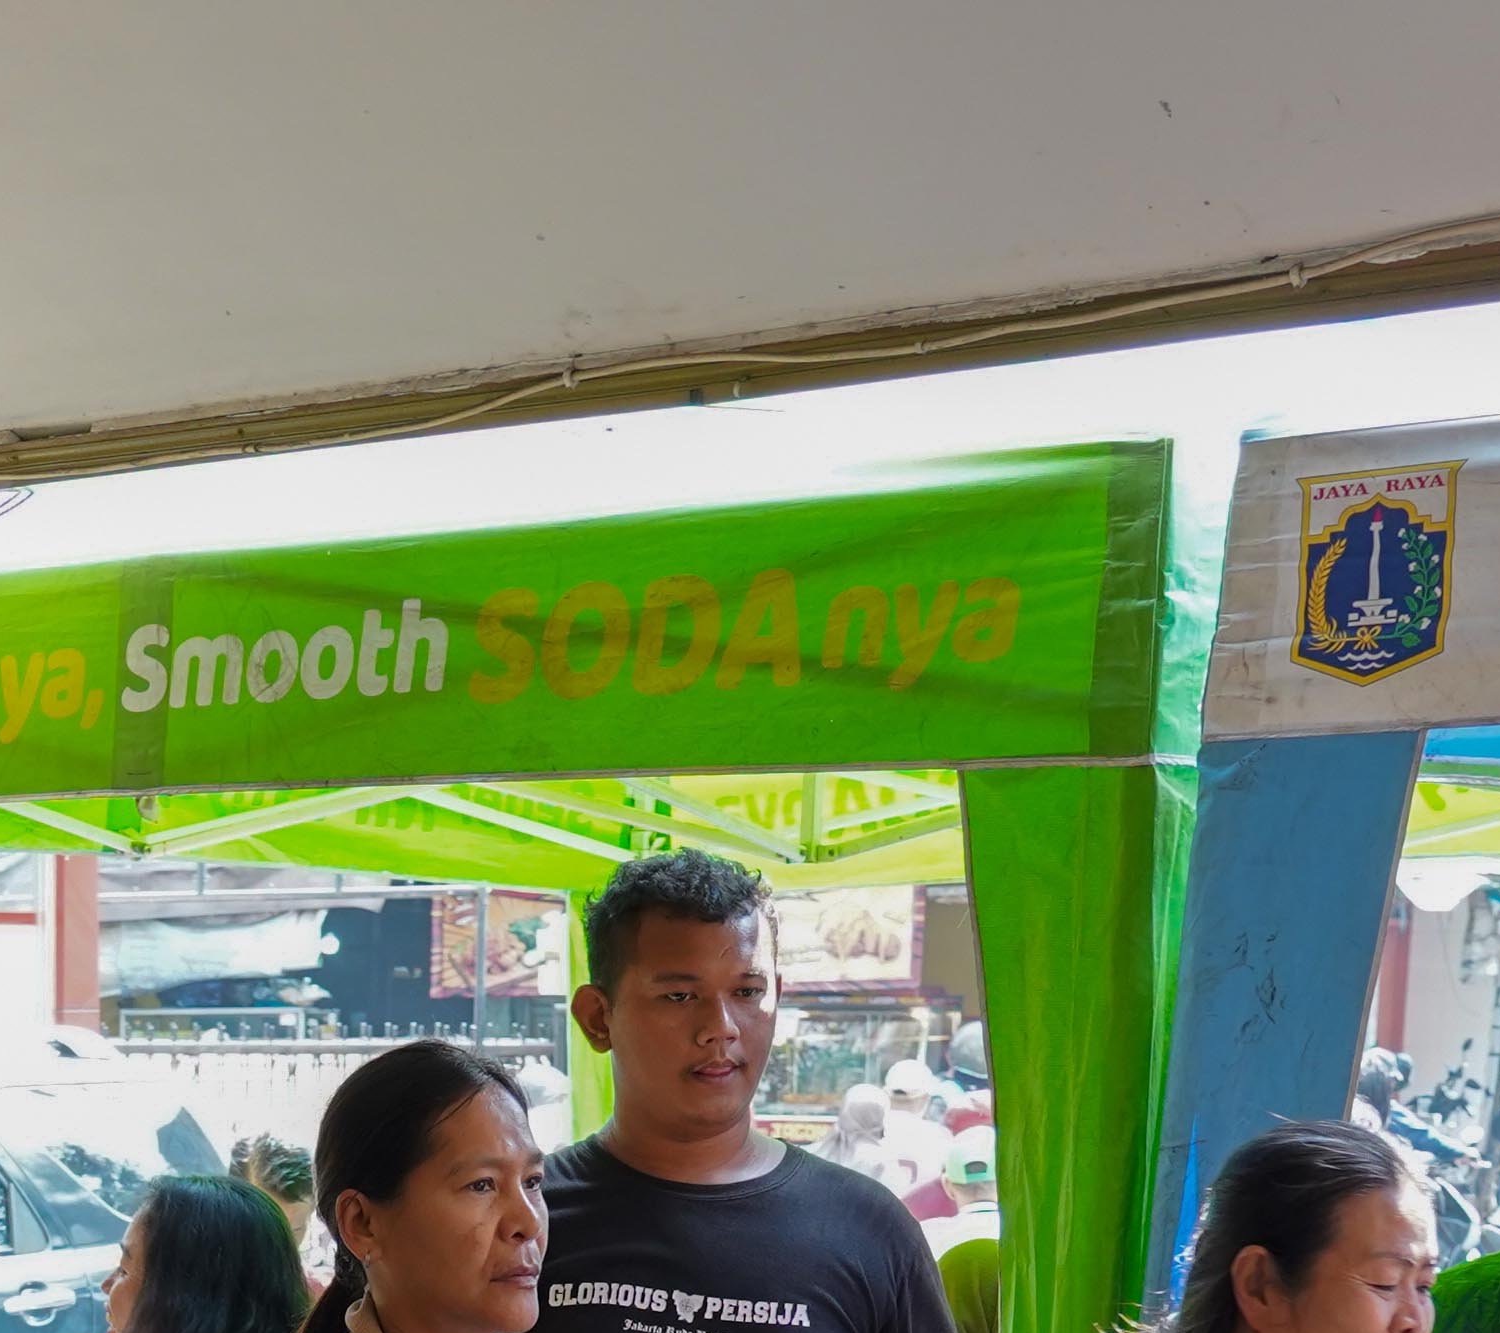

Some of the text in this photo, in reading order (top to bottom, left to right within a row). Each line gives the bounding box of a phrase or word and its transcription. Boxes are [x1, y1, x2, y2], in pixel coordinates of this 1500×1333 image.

[1312, 473, 1445, 502] JAYA RAYA
[120, 599, 450, 713] Smooth
[548, 1282, 811, 1327] GLORIOUS PERSIJA
[622, 1318, 662, 1333] Jakarta
